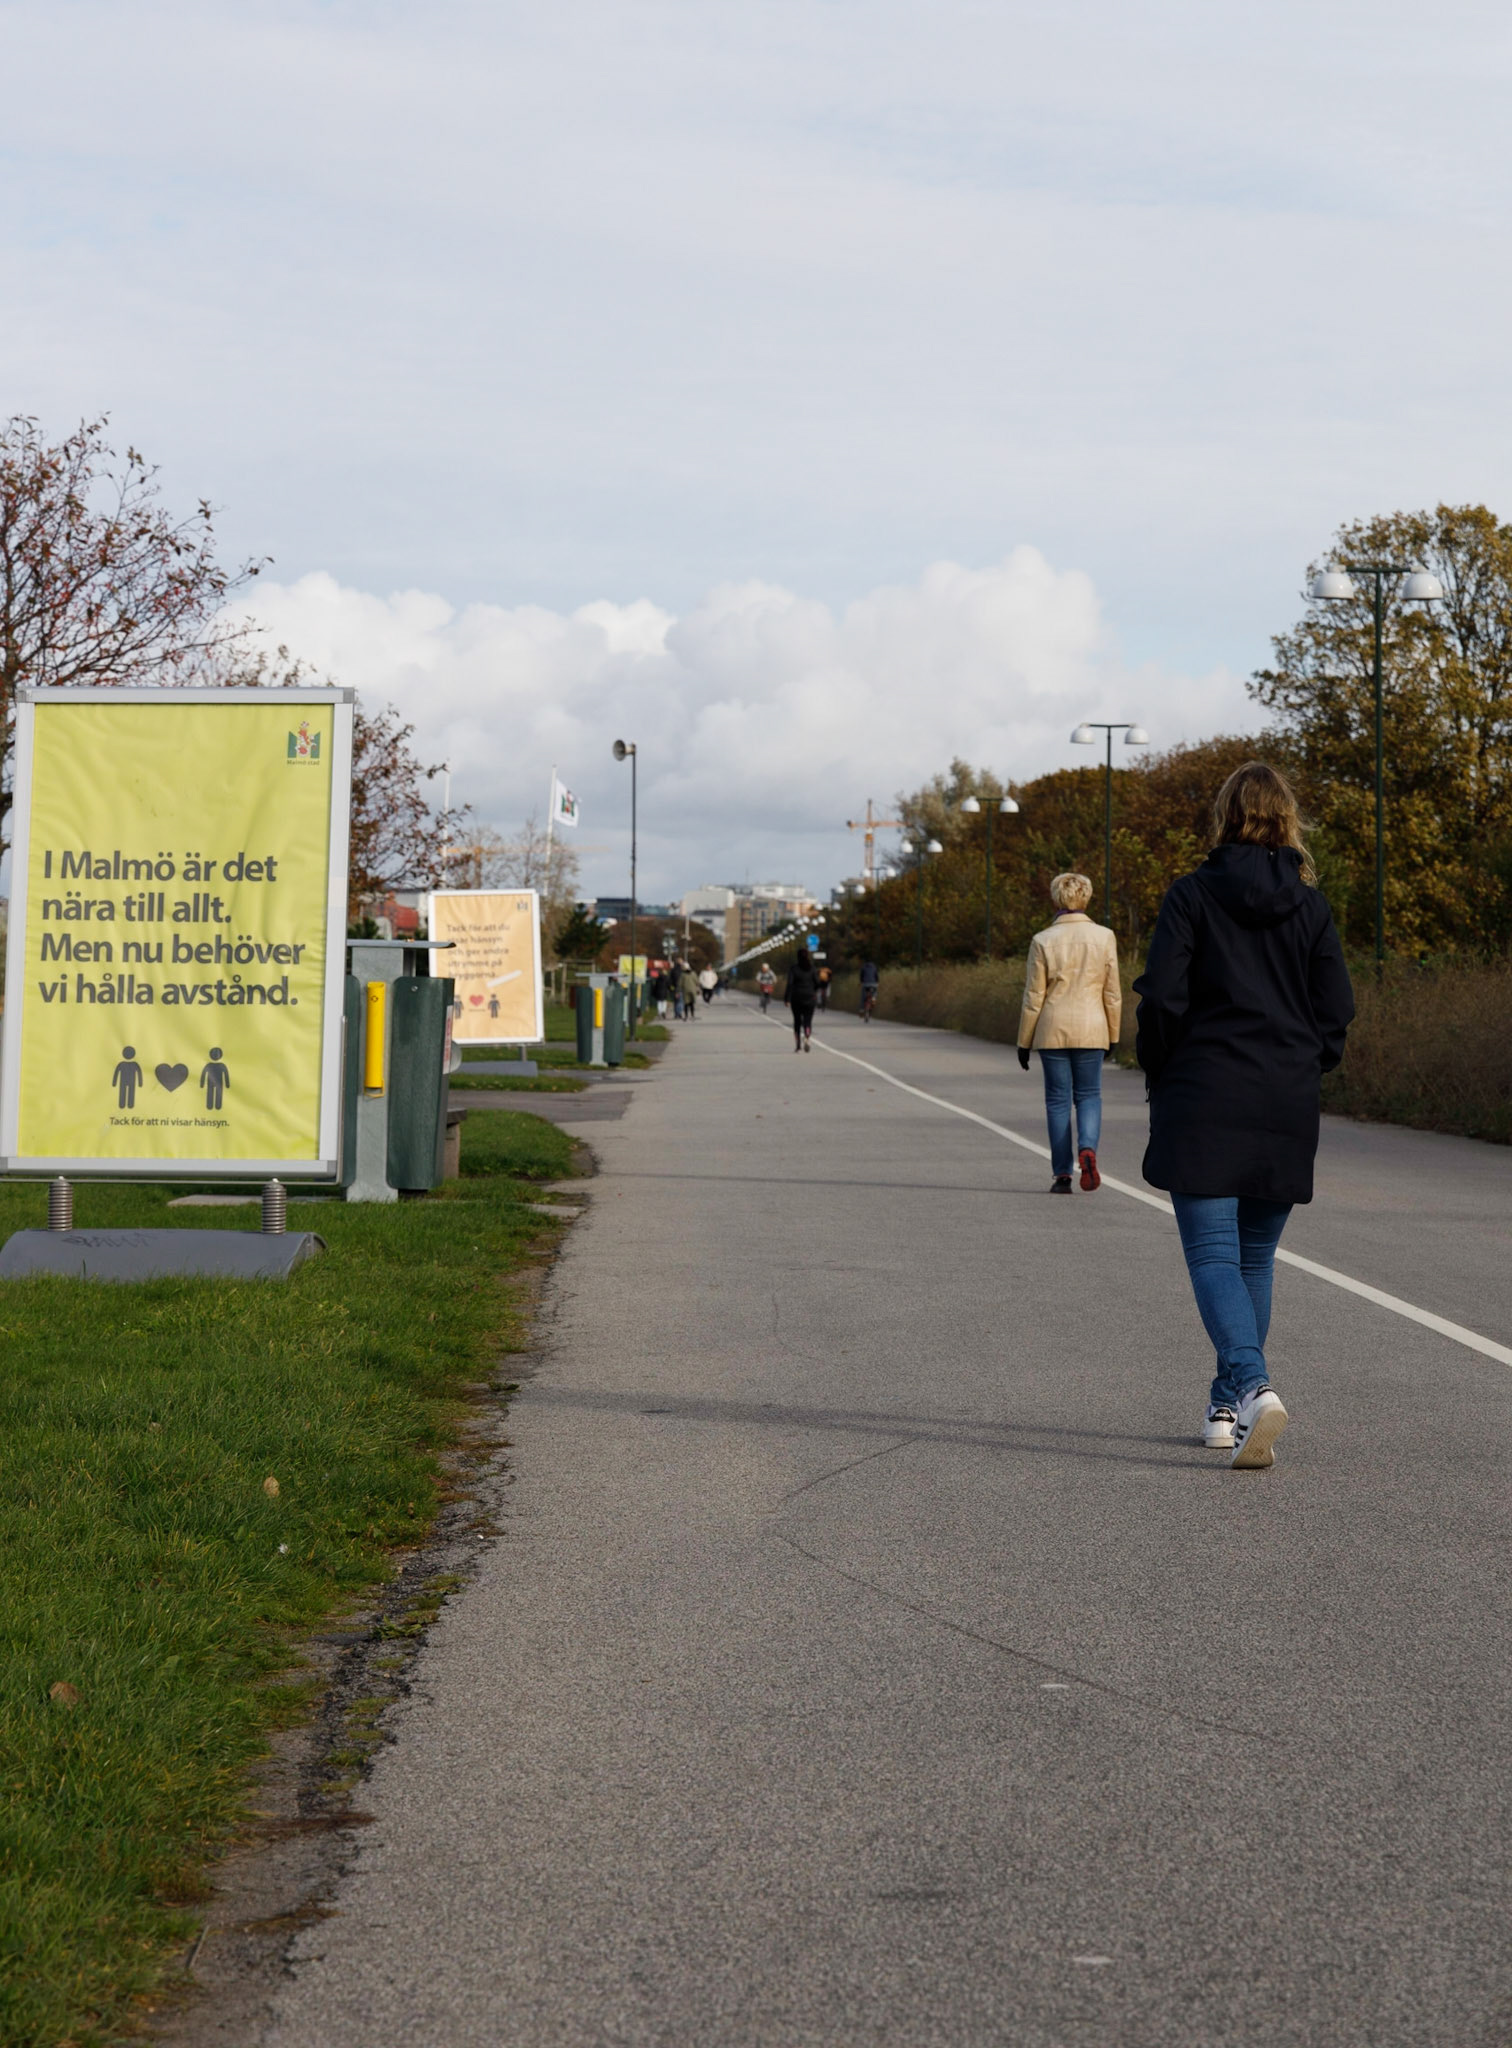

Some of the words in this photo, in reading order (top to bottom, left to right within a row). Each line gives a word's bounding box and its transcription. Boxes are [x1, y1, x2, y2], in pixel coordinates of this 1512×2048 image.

[44, 850, 53, 879] I
[60, 850, 176, 881] Malmö
[182, 852, 217, 882] är
[223, 852, 278, 882] det
[42, 891, 115, 921] nära
[123, 892, 165, 922] till
[172, 893, 232, 924] allt.
[40, 933, 113, 963] Men
[122, 941, 163, 964] nu
[171, 934, 306, 965] behöver
[38, 973, 68, 1004] vi
[76, 973, 154, 1005] hålla
[161, 974, 299, 1006] avstånd.
[109, 1116, 130, 1126] Tack
[131, 1117, 145, 1126] för
[146, 1117, 159, 1126] att
[160, 1117, 170, 1126] ni
[171, 1117, 193, 1127] visar
[194, 1117, 231, 1129] hänsyn.
